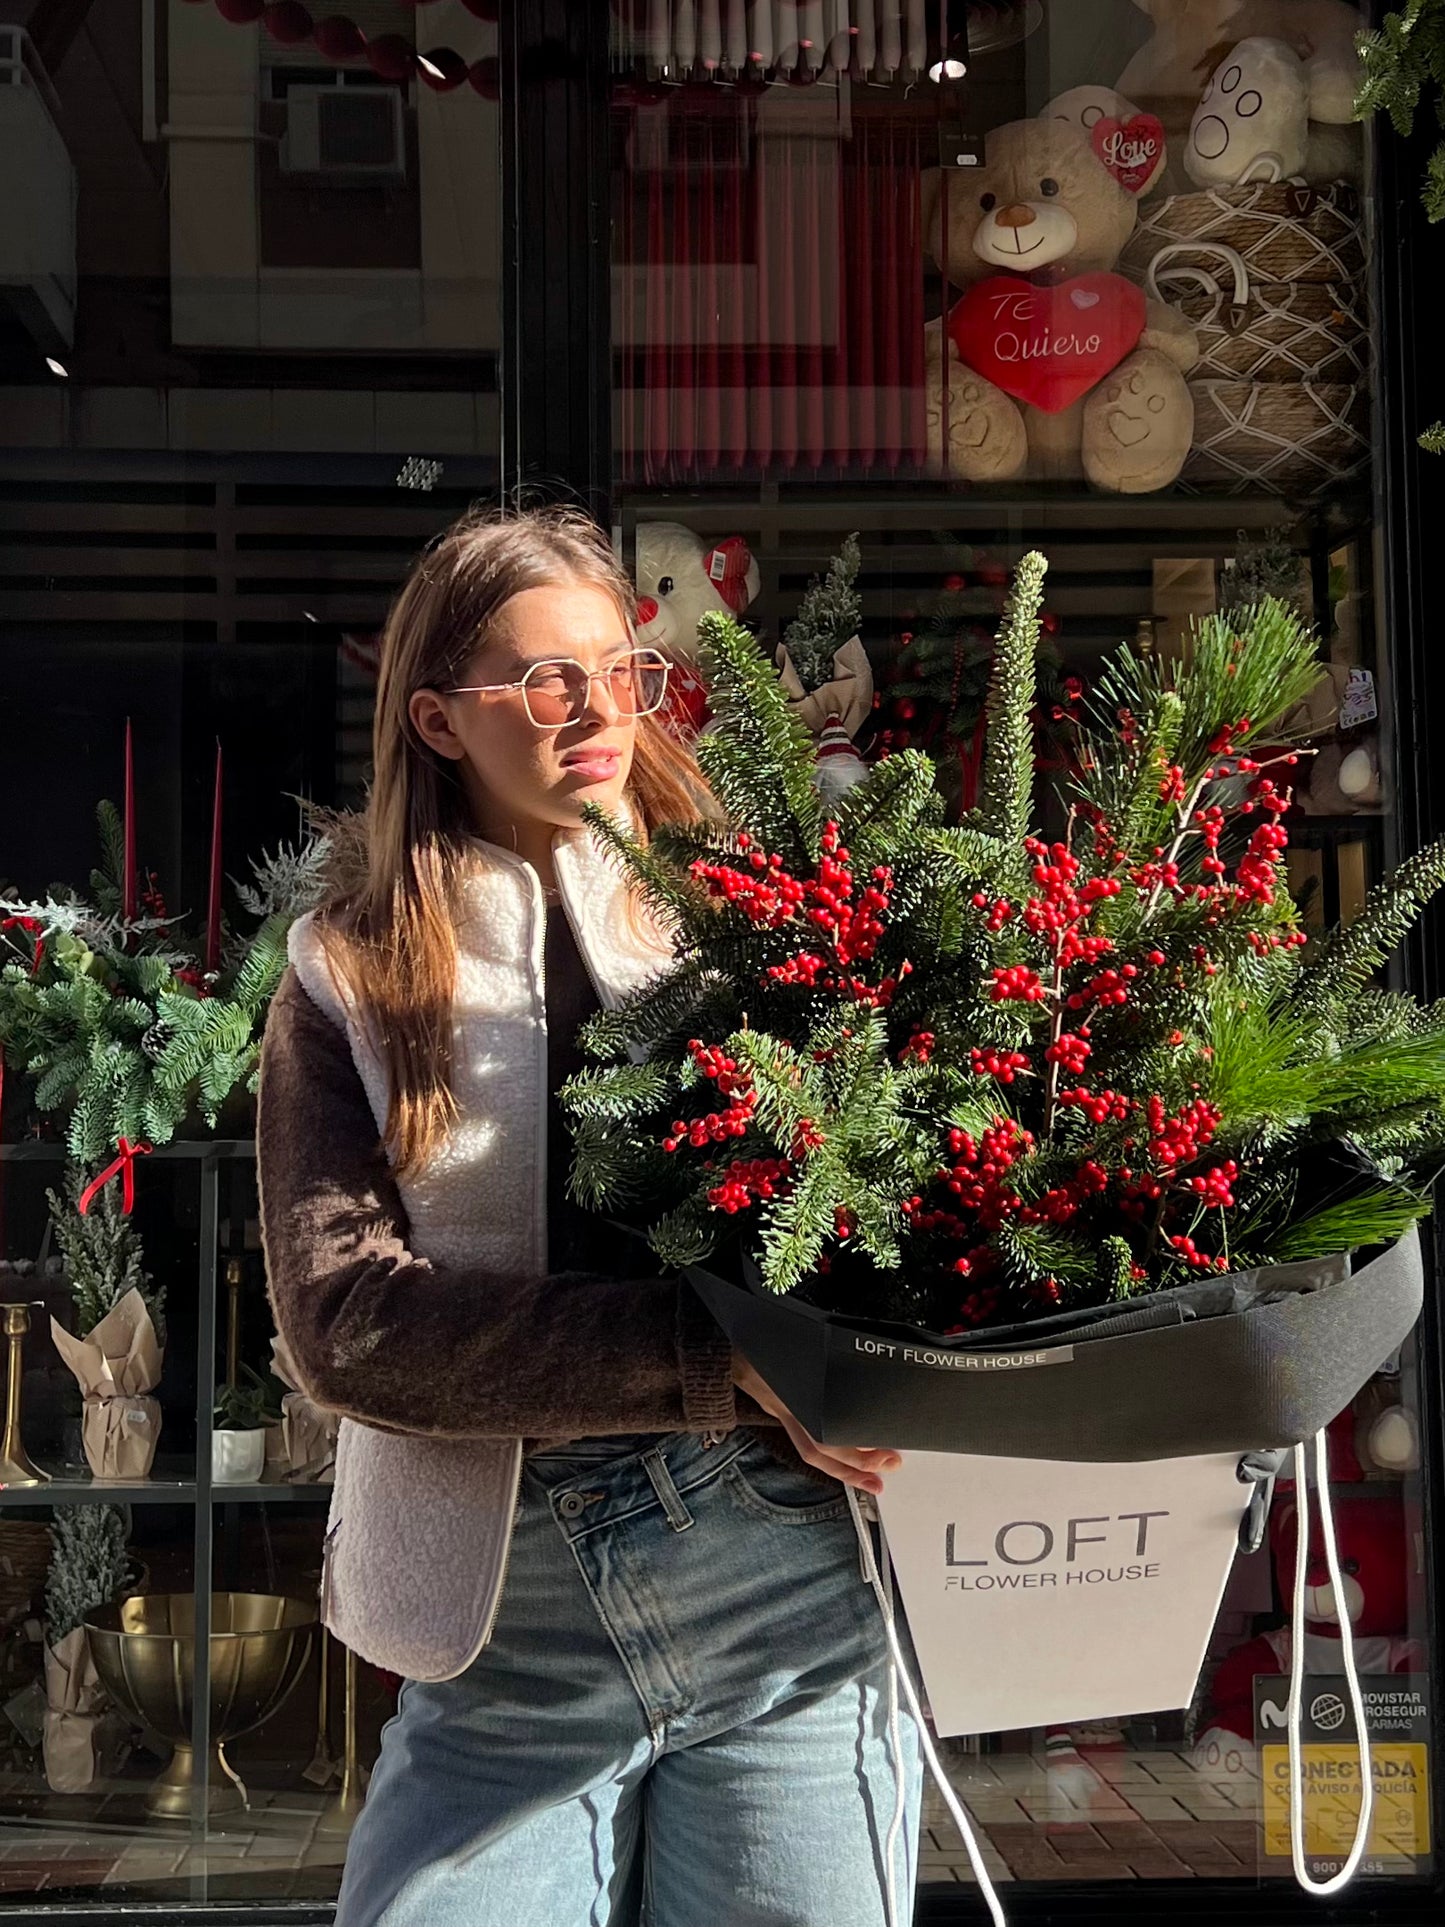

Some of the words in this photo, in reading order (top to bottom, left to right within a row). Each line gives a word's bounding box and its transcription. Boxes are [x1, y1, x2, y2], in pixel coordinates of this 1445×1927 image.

[1102, 131, 1157, 168] Love
[989, 292, 1036, 320] TE
[994, 327, 1100, 362] Quiero
[855, 1337, 896, 1358] LOFT
[903, 1348, 979, 1369] FLOWER
[983, 1353, 1047, 1368] HOUSE
[945, 1510, 1170, 1566] LOFT
[945, 1572, 1058, 1591] FLOWER
[1066, 1563, 1161, 1585] HOUSE
[1363, 1706, 1427, 1717] ROSEGUR
[1366, 1719, 1413, 1729] LARMAS
[1309, 1783, 1350, 1794] AVISO
[1373, 1780, 1417, 1794] OLICÍA
[1313, 1862, 1337, 1873] 900
